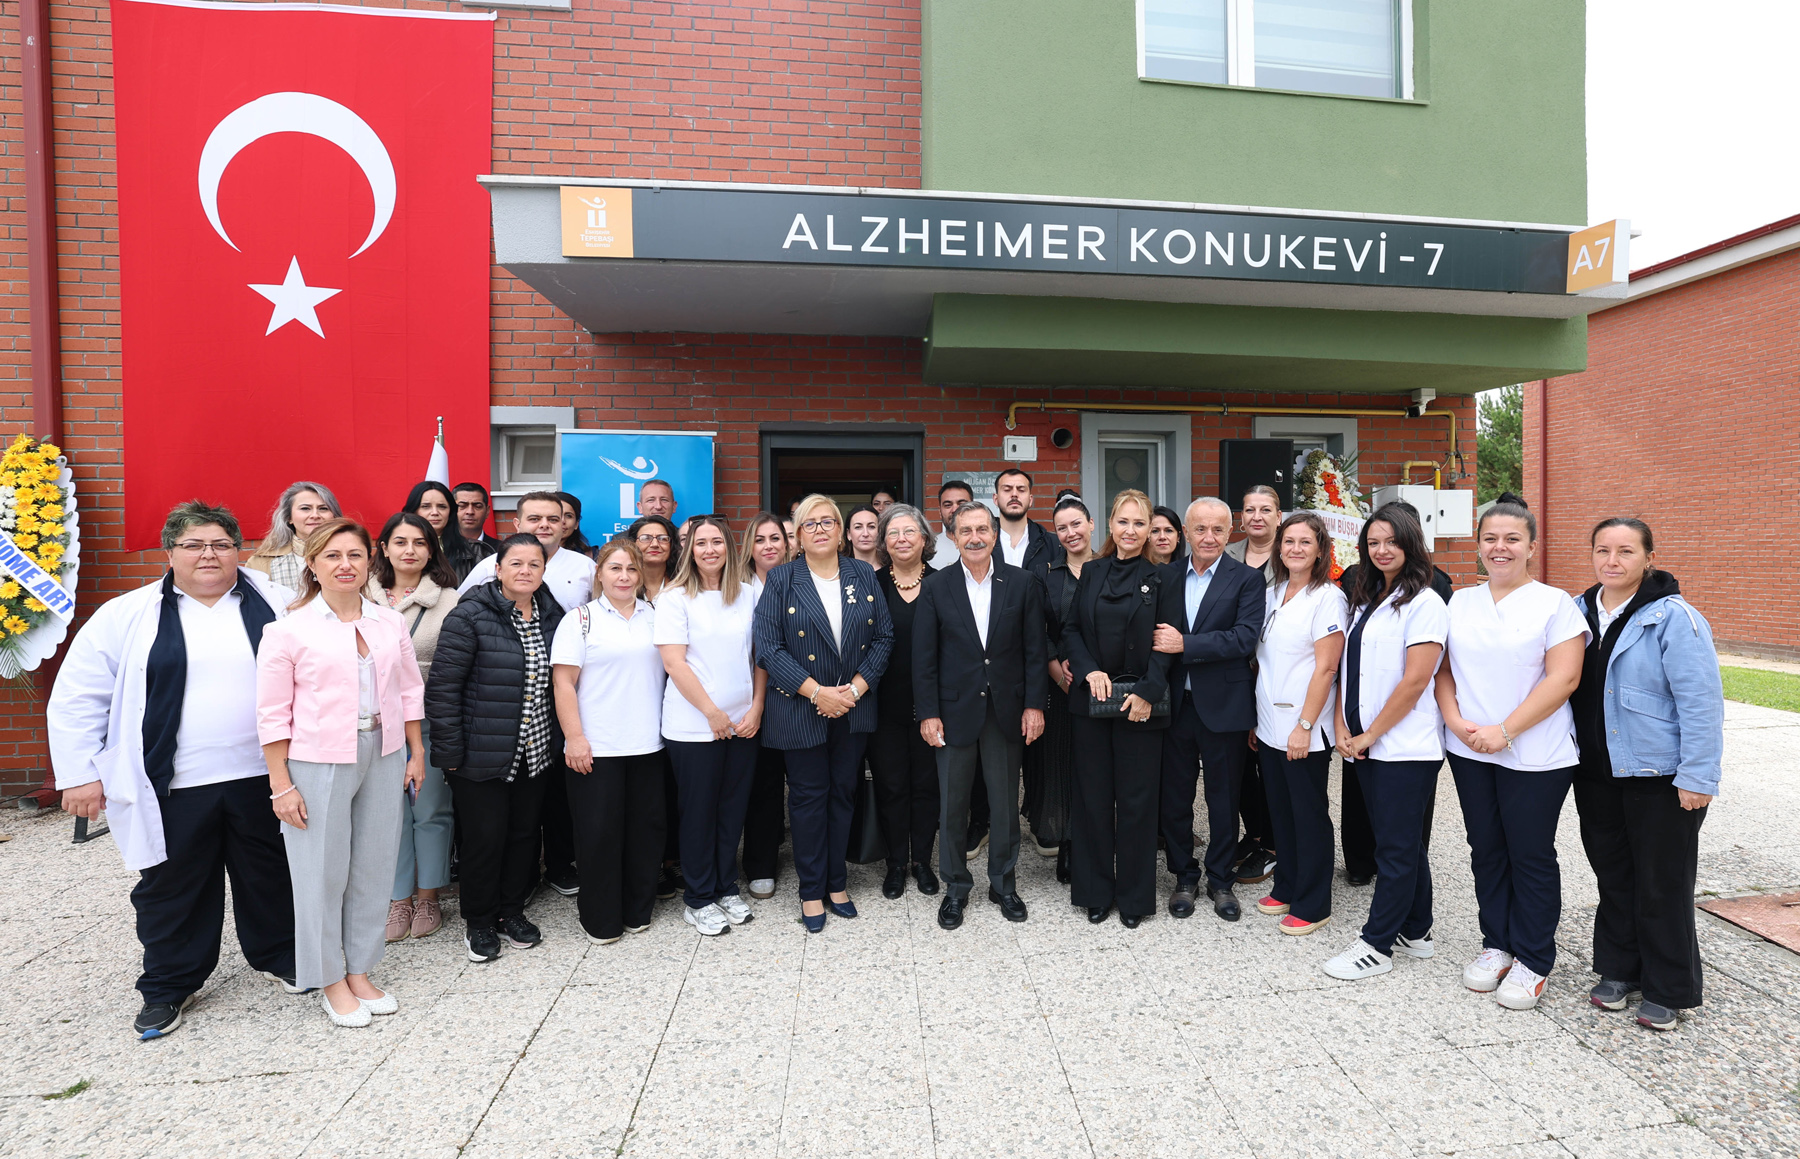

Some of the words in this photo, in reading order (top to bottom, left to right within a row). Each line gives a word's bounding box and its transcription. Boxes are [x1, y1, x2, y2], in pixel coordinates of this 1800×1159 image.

[580, 234, 614, 243] TEPEBAŞI
[782, 213, 1106, 261] ALZHEIMER
[1572, 236, 1611, 276] A7
[32, 580, 74, 615] ART
